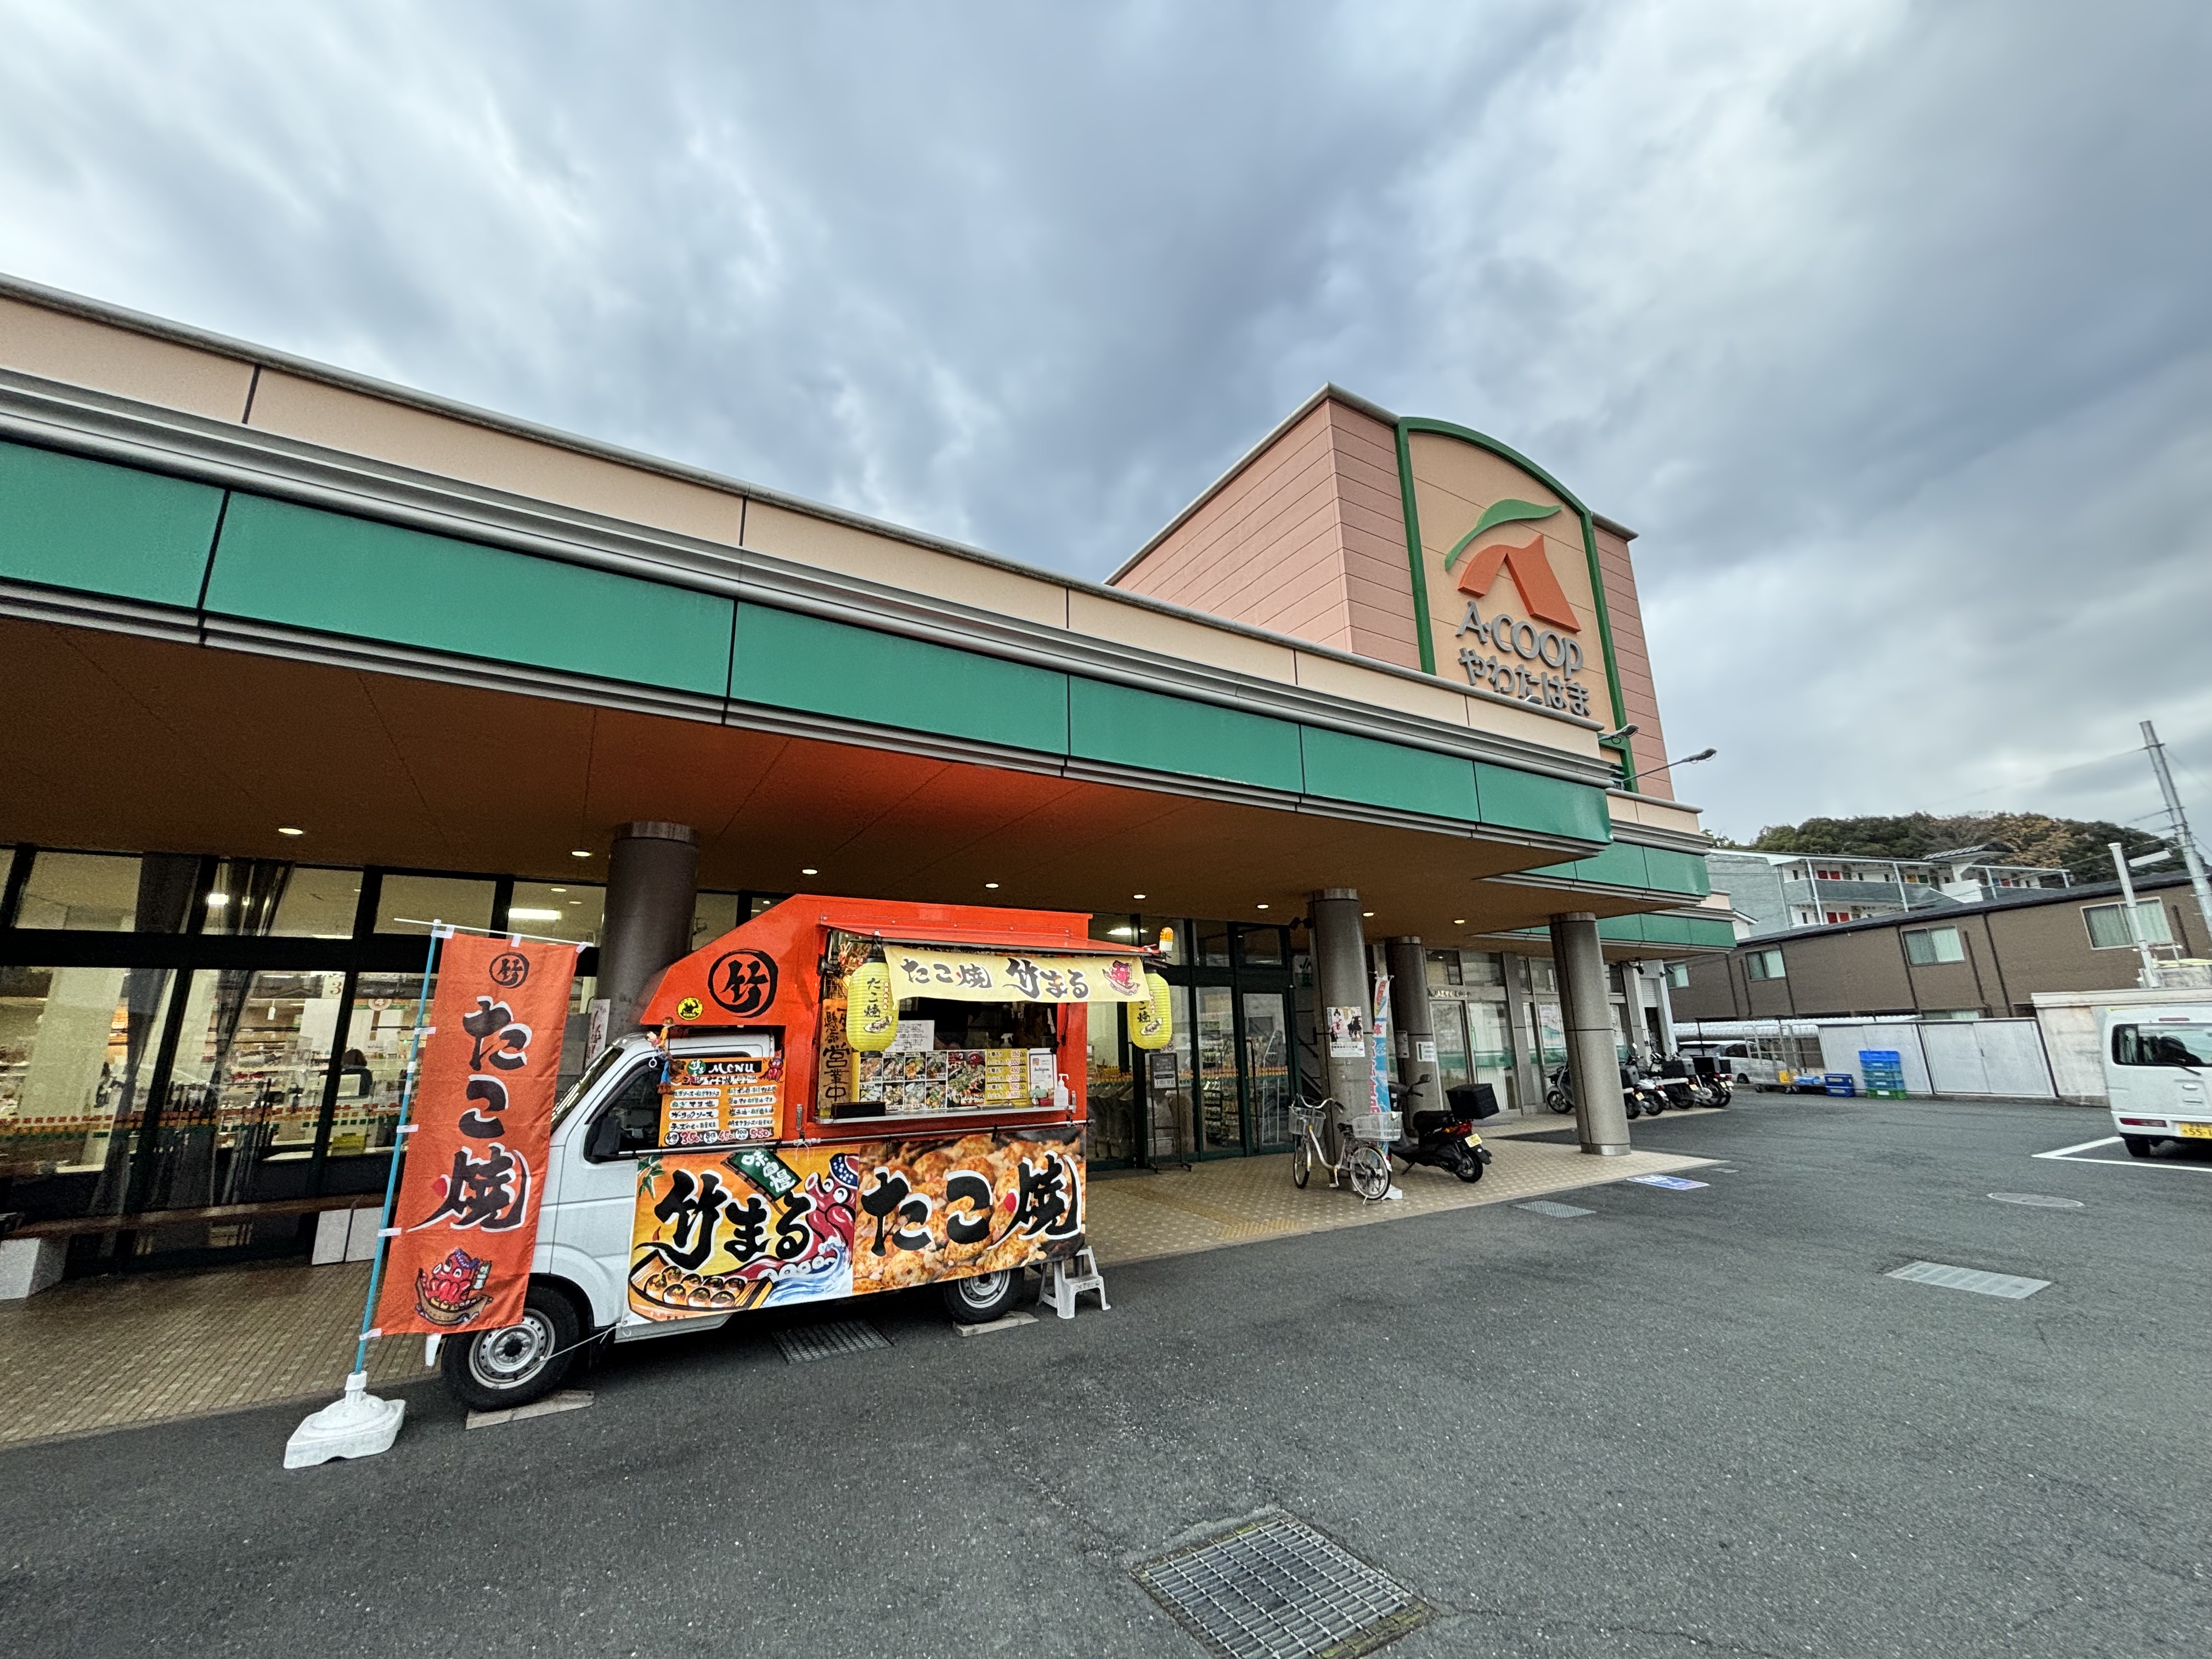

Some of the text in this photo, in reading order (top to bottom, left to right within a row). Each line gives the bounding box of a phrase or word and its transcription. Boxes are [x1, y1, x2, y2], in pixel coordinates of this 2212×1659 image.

[1458, 647, 1591, 716] やわたはま
[330, 981, 342, 995] 3
[863, 977, 881, 1018] たこ焼
[900, 957, 1090, 999] たこ焼 竹まる
[1137, 1001, 1151, 1023] こ焼
[822, 1042, 850, 1102] 営業中
[407, 996, 532, 1232] たこ焼
[750, 1128, 769, 1138] 550
[681, 1131, 699, 1144] 350
[718, 1130, 733, 1141] 450
[636, 1169, 816, 1271] 竹まる
[862, 1150, 1082, 1257] たこ焼
